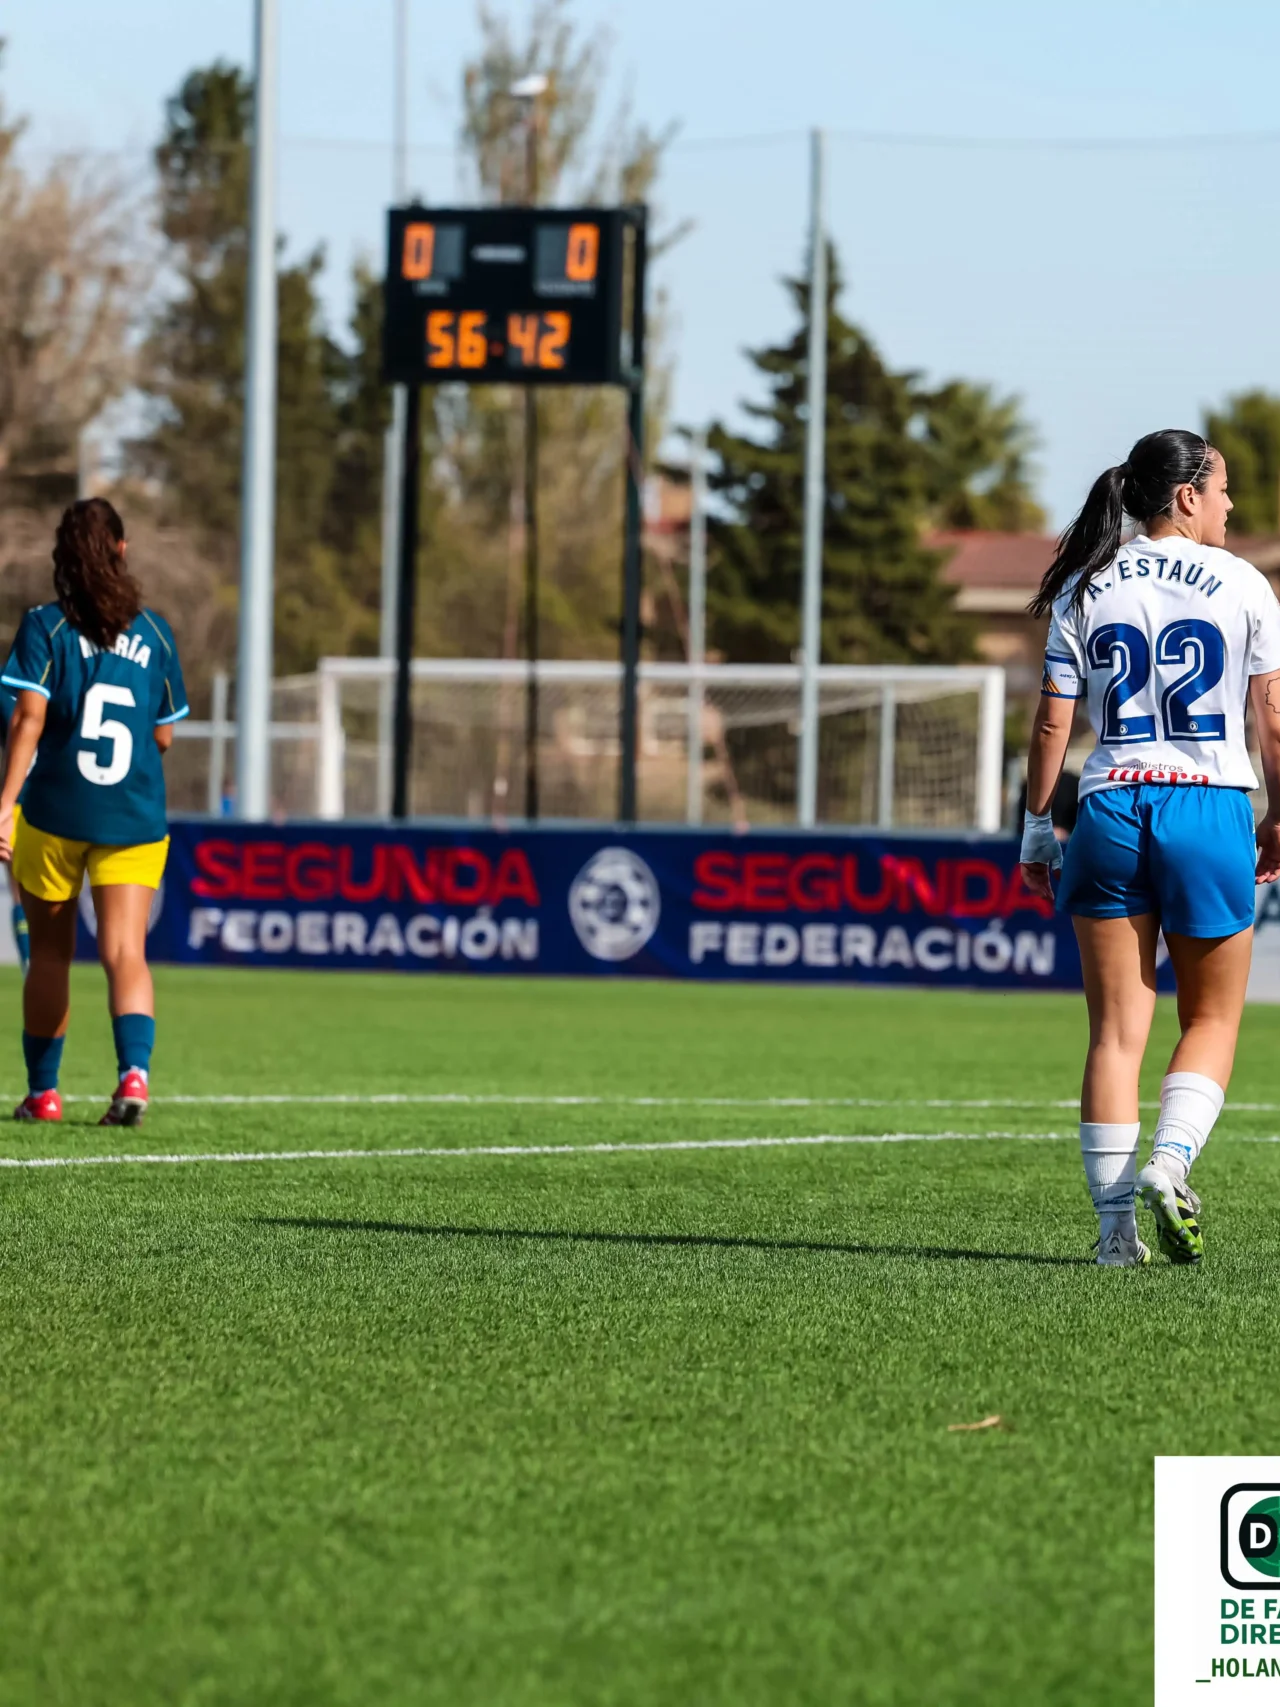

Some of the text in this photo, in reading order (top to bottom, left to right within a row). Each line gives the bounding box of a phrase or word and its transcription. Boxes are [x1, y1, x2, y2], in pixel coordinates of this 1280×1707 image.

[402, 221, 599, 281] 0 0
[1117, 558, 1223, 598] ESTAÚN
[1087, 619, 1226, 745] 22
[77, 683, 136, 785] 5
[190, 838, 541, 907] SEGUNDA
[188, 904, 540, 960] FEDERACIÓN
[689, 919, 1056, 976] FEDERACIÓN
